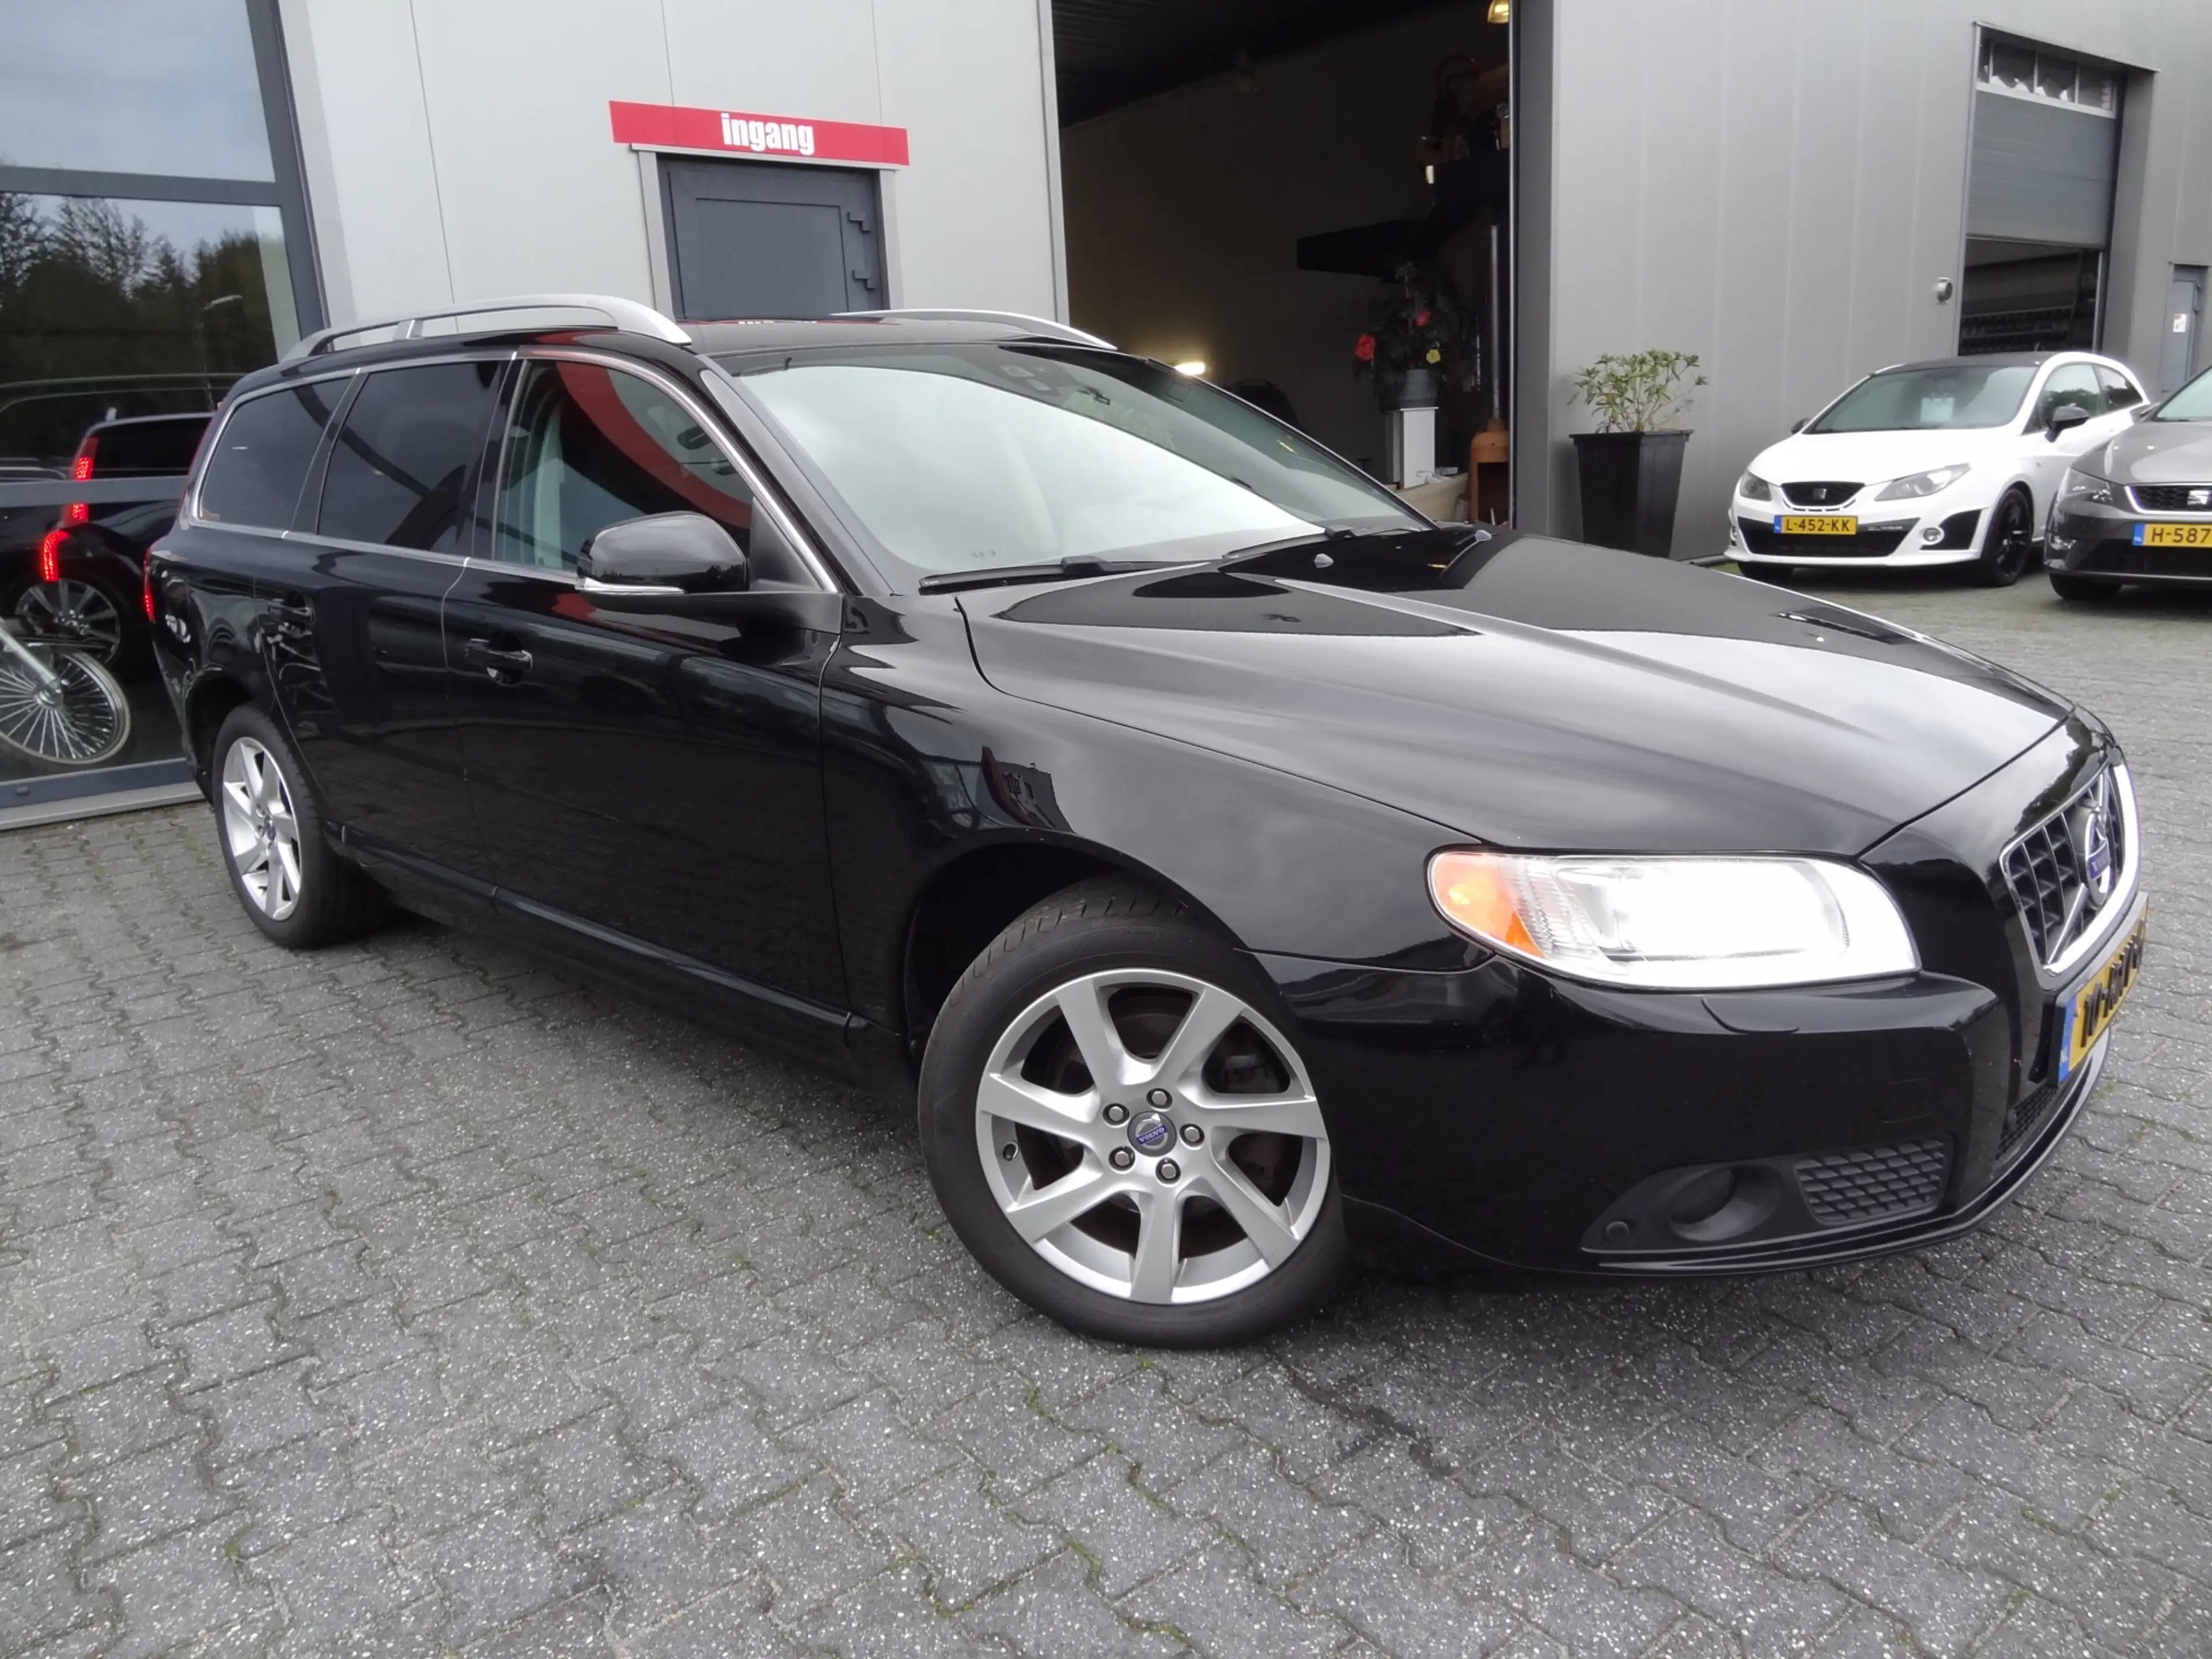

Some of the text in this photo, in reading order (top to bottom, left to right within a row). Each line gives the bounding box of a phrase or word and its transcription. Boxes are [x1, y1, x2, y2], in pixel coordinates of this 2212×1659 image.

[721, 112, 815, 156] ingang
[1786, 518, 1850, 532] L-452-KK
[2151, 527, 2211, 543] H-587
[1138, 1127, 1165, 1142] VOLVO
